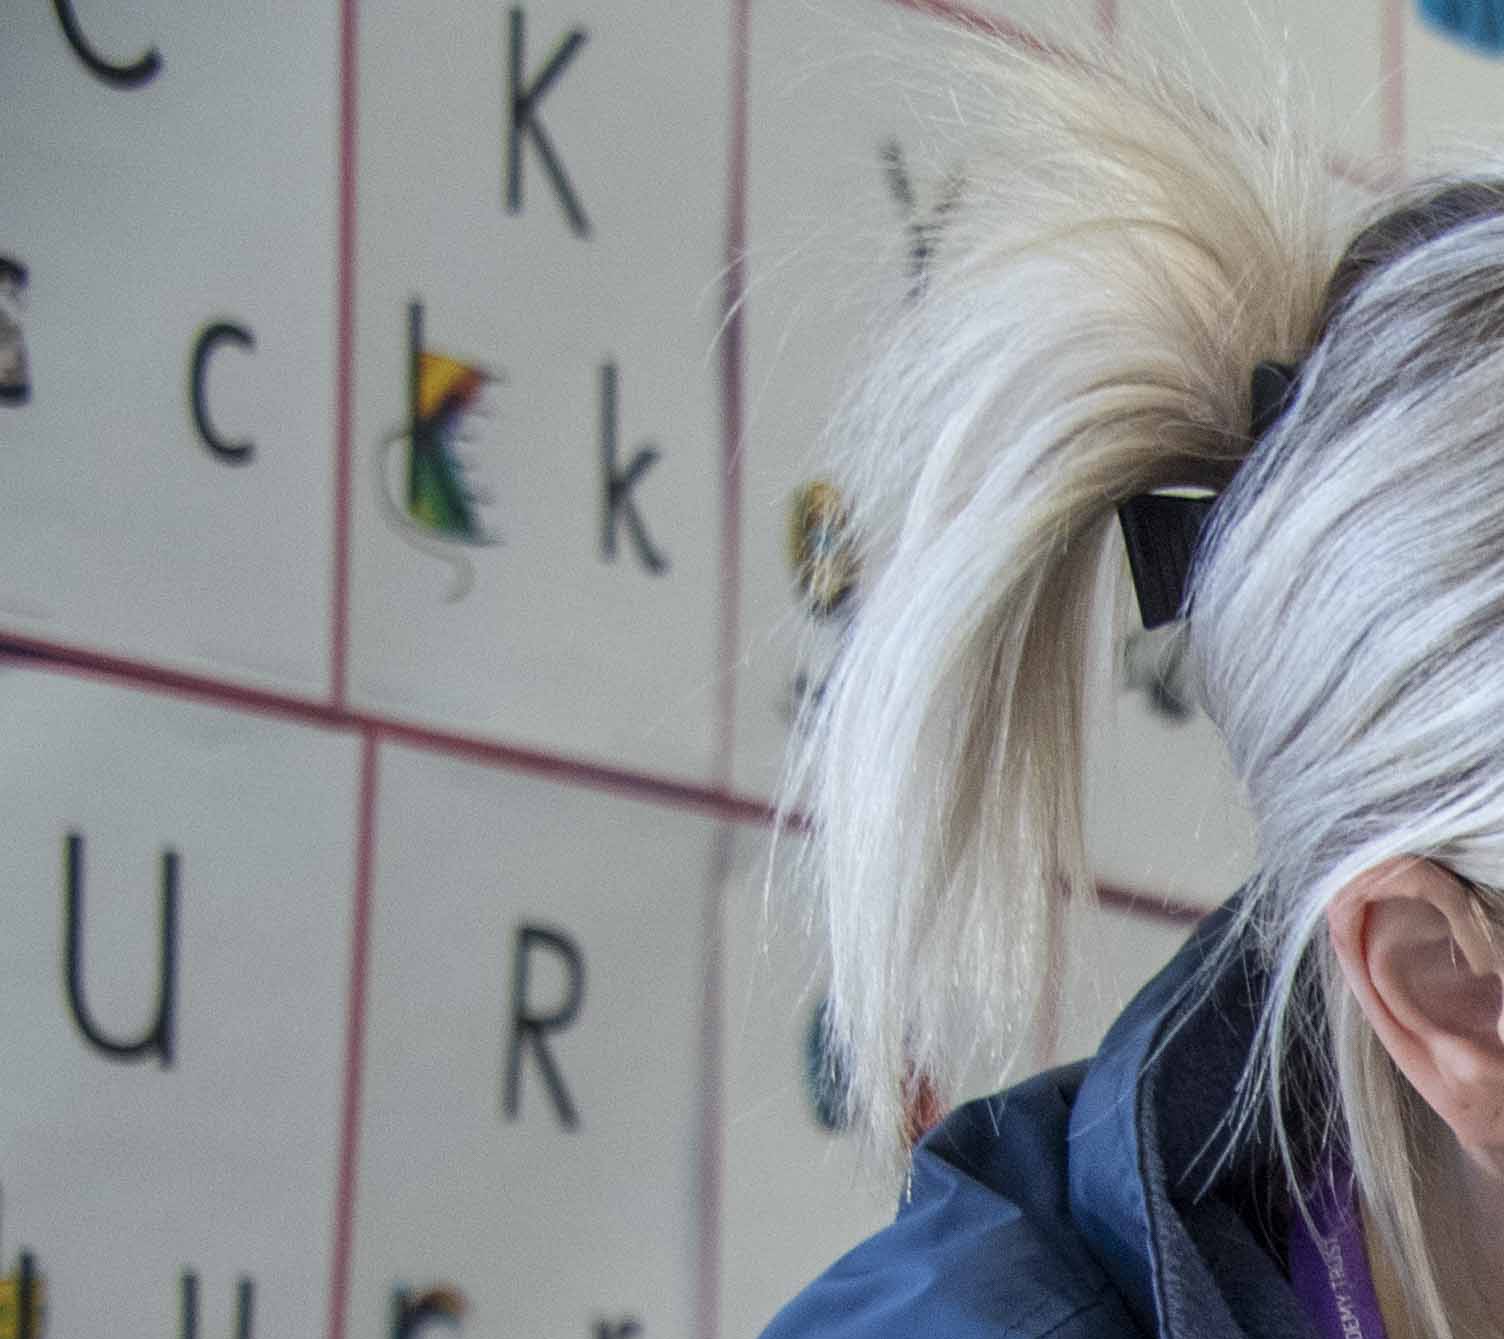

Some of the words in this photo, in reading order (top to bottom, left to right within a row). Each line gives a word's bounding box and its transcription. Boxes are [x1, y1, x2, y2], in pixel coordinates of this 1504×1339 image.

[505, 5, 592, 240] K
[188, 317, 258, 468] c
[598, 358, 670, 578] k
[60, 828, 180, 1070] U
[501, 915, 588, 1134] R
